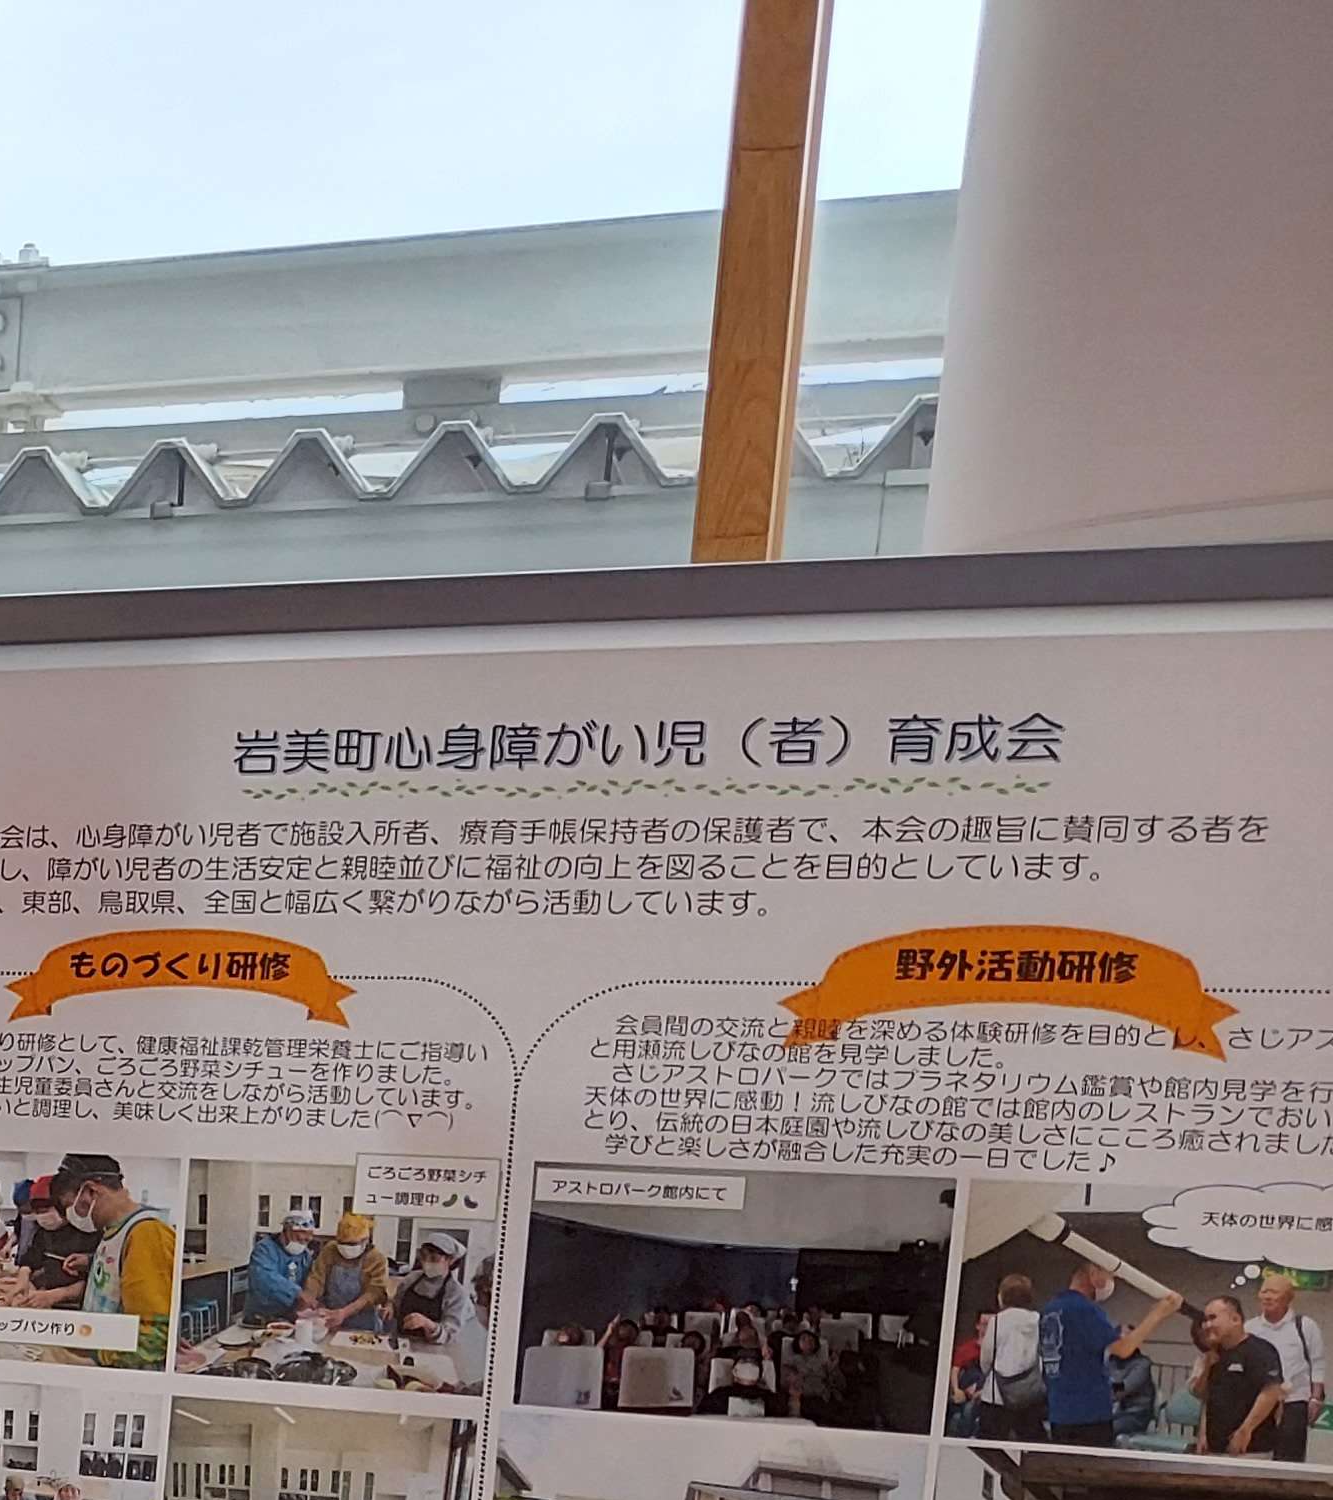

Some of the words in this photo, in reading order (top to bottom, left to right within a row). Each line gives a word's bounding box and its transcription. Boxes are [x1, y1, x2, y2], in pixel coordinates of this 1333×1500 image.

[69, 951, 291, 981] ものづくり研修
[893, 947, 1139, 984] 野外活動研修
[552, 1179, 728, 1202] アストロパーク館内にて
